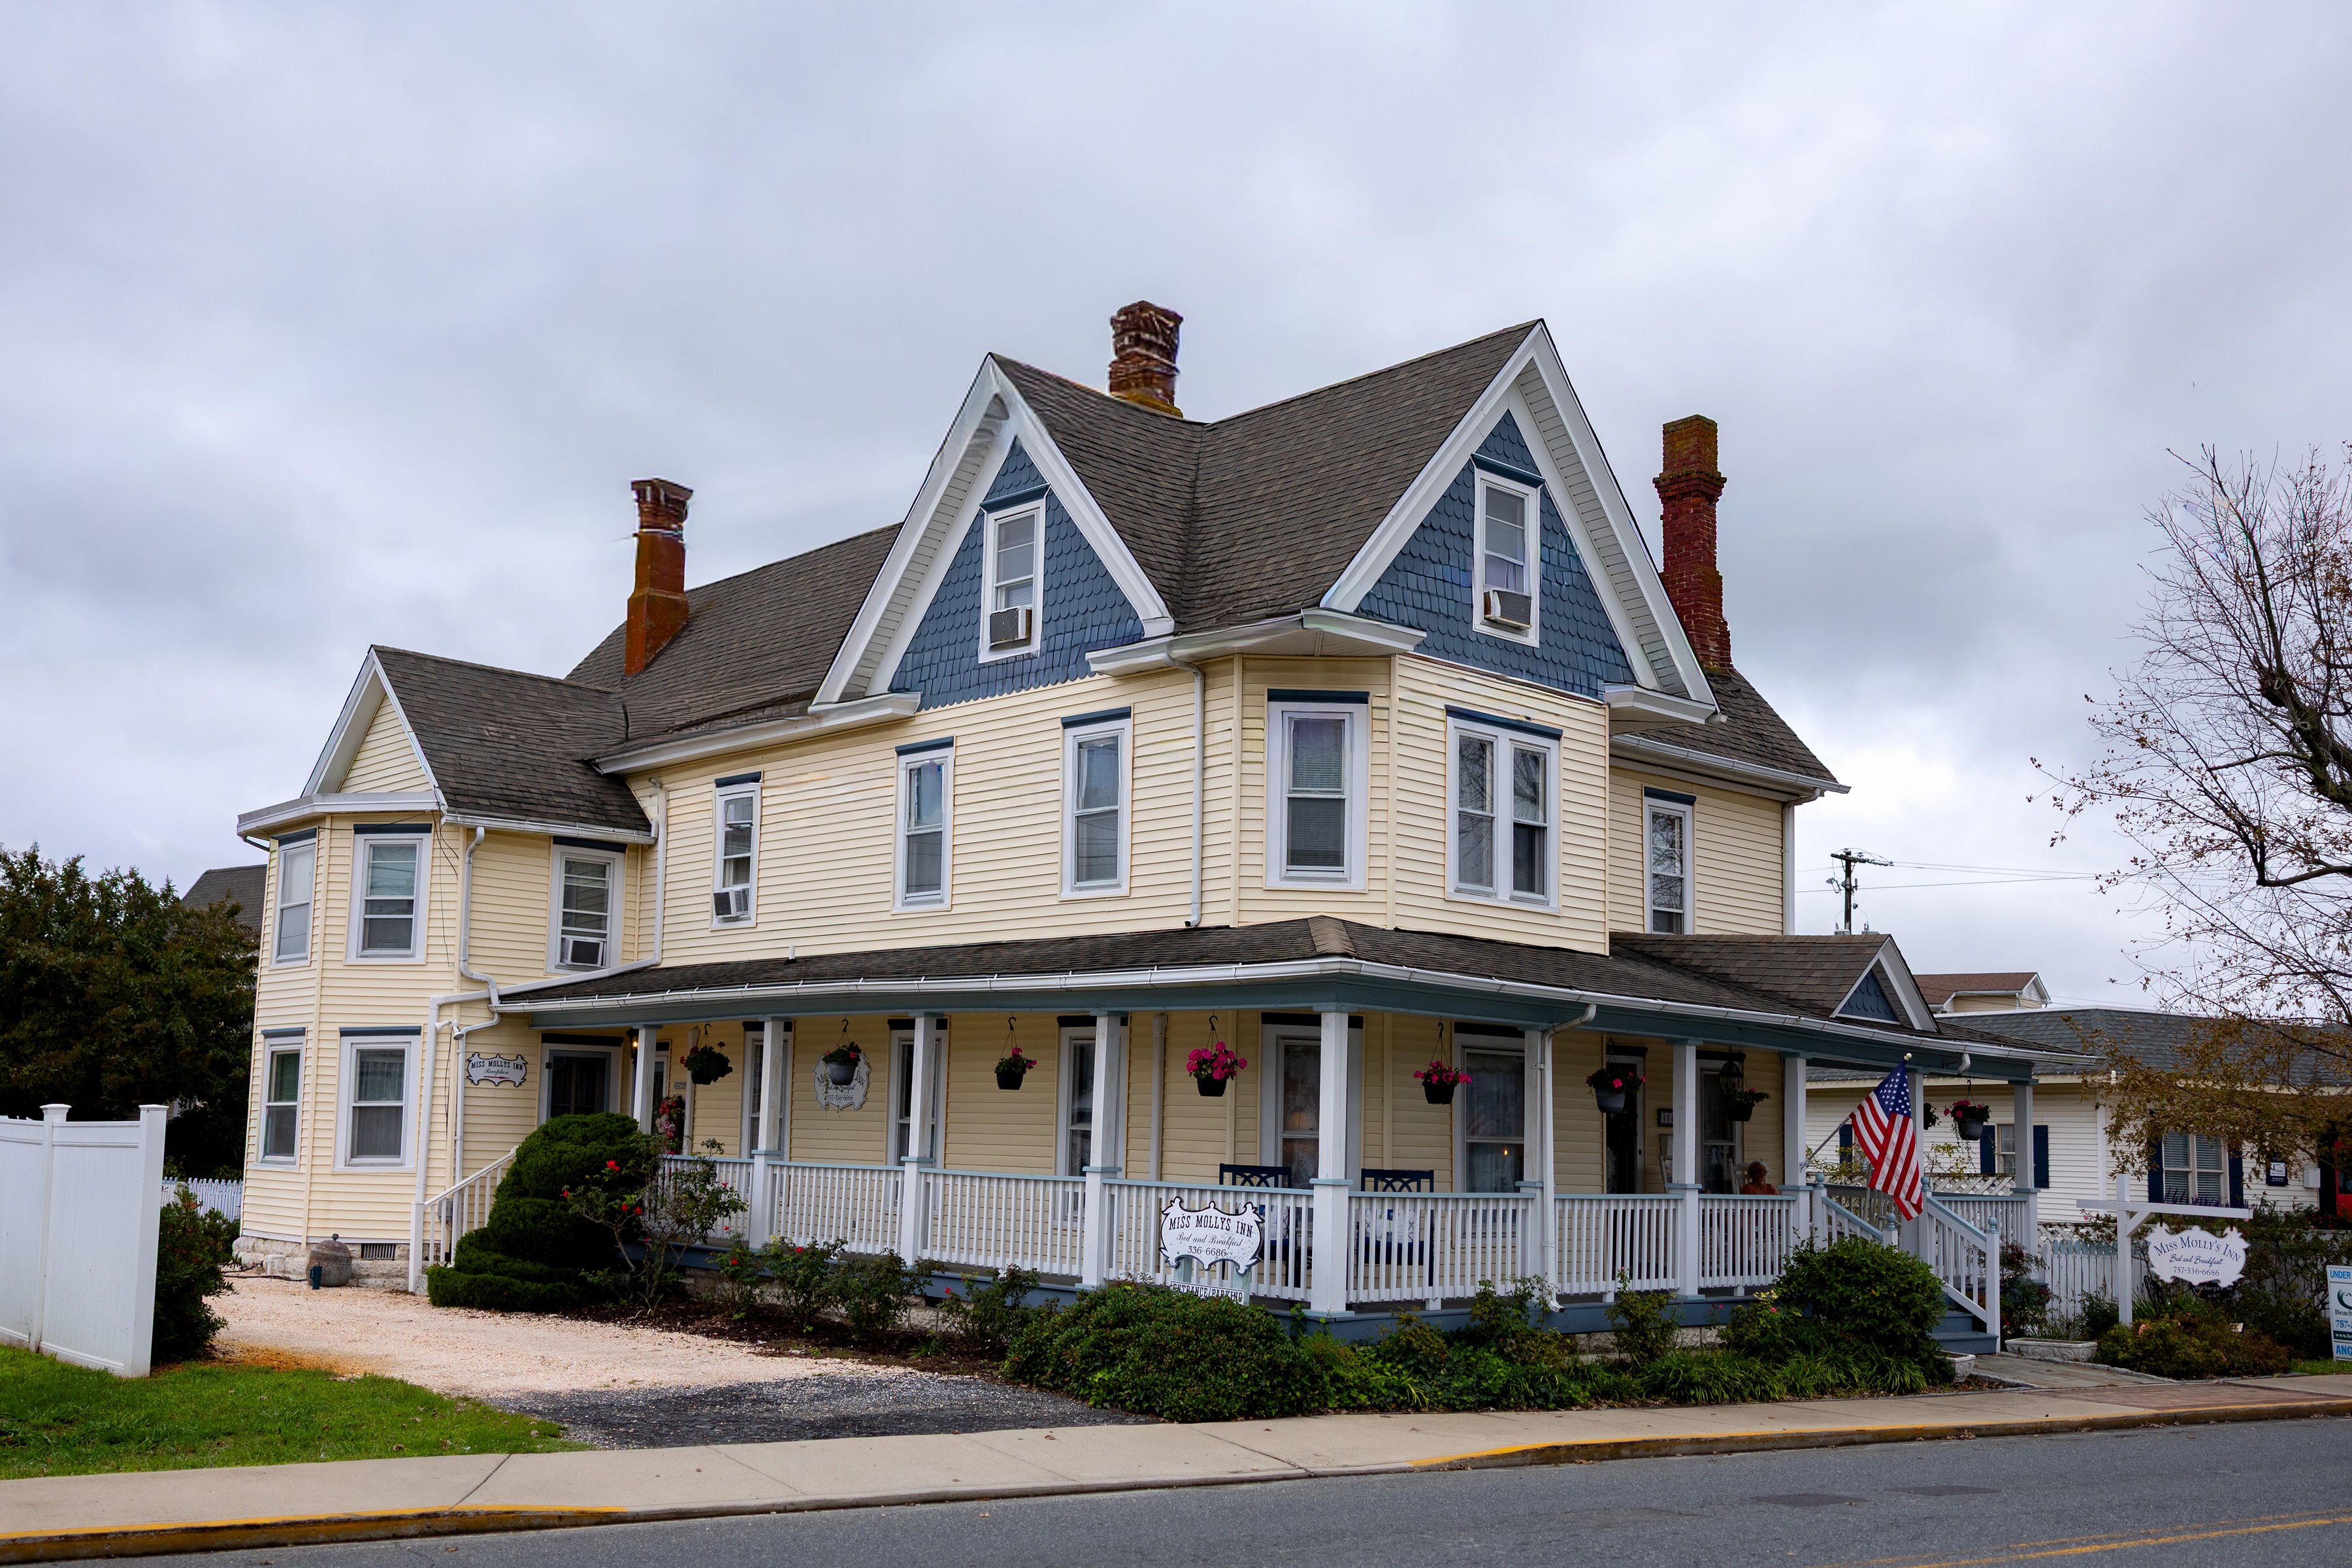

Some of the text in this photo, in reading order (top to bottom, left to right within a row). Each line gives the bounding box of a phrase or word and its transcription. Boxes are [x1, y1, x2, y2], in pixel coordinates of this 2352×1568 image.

[513, 1062, 523, 1071] INN
[1169, 1215, 1253, 1238] MISS MOLLYS INN
[1176, 1232, 1243, 1249] Bed and Breakfast
[1187, 1246, 1226, 1257] 336-6686
[2169, 1254, 2183, 1262] Bed
[2194, 1255, 2223, 1267] Breakfast
[2330, 1270, 2351, 1279] UNDER
